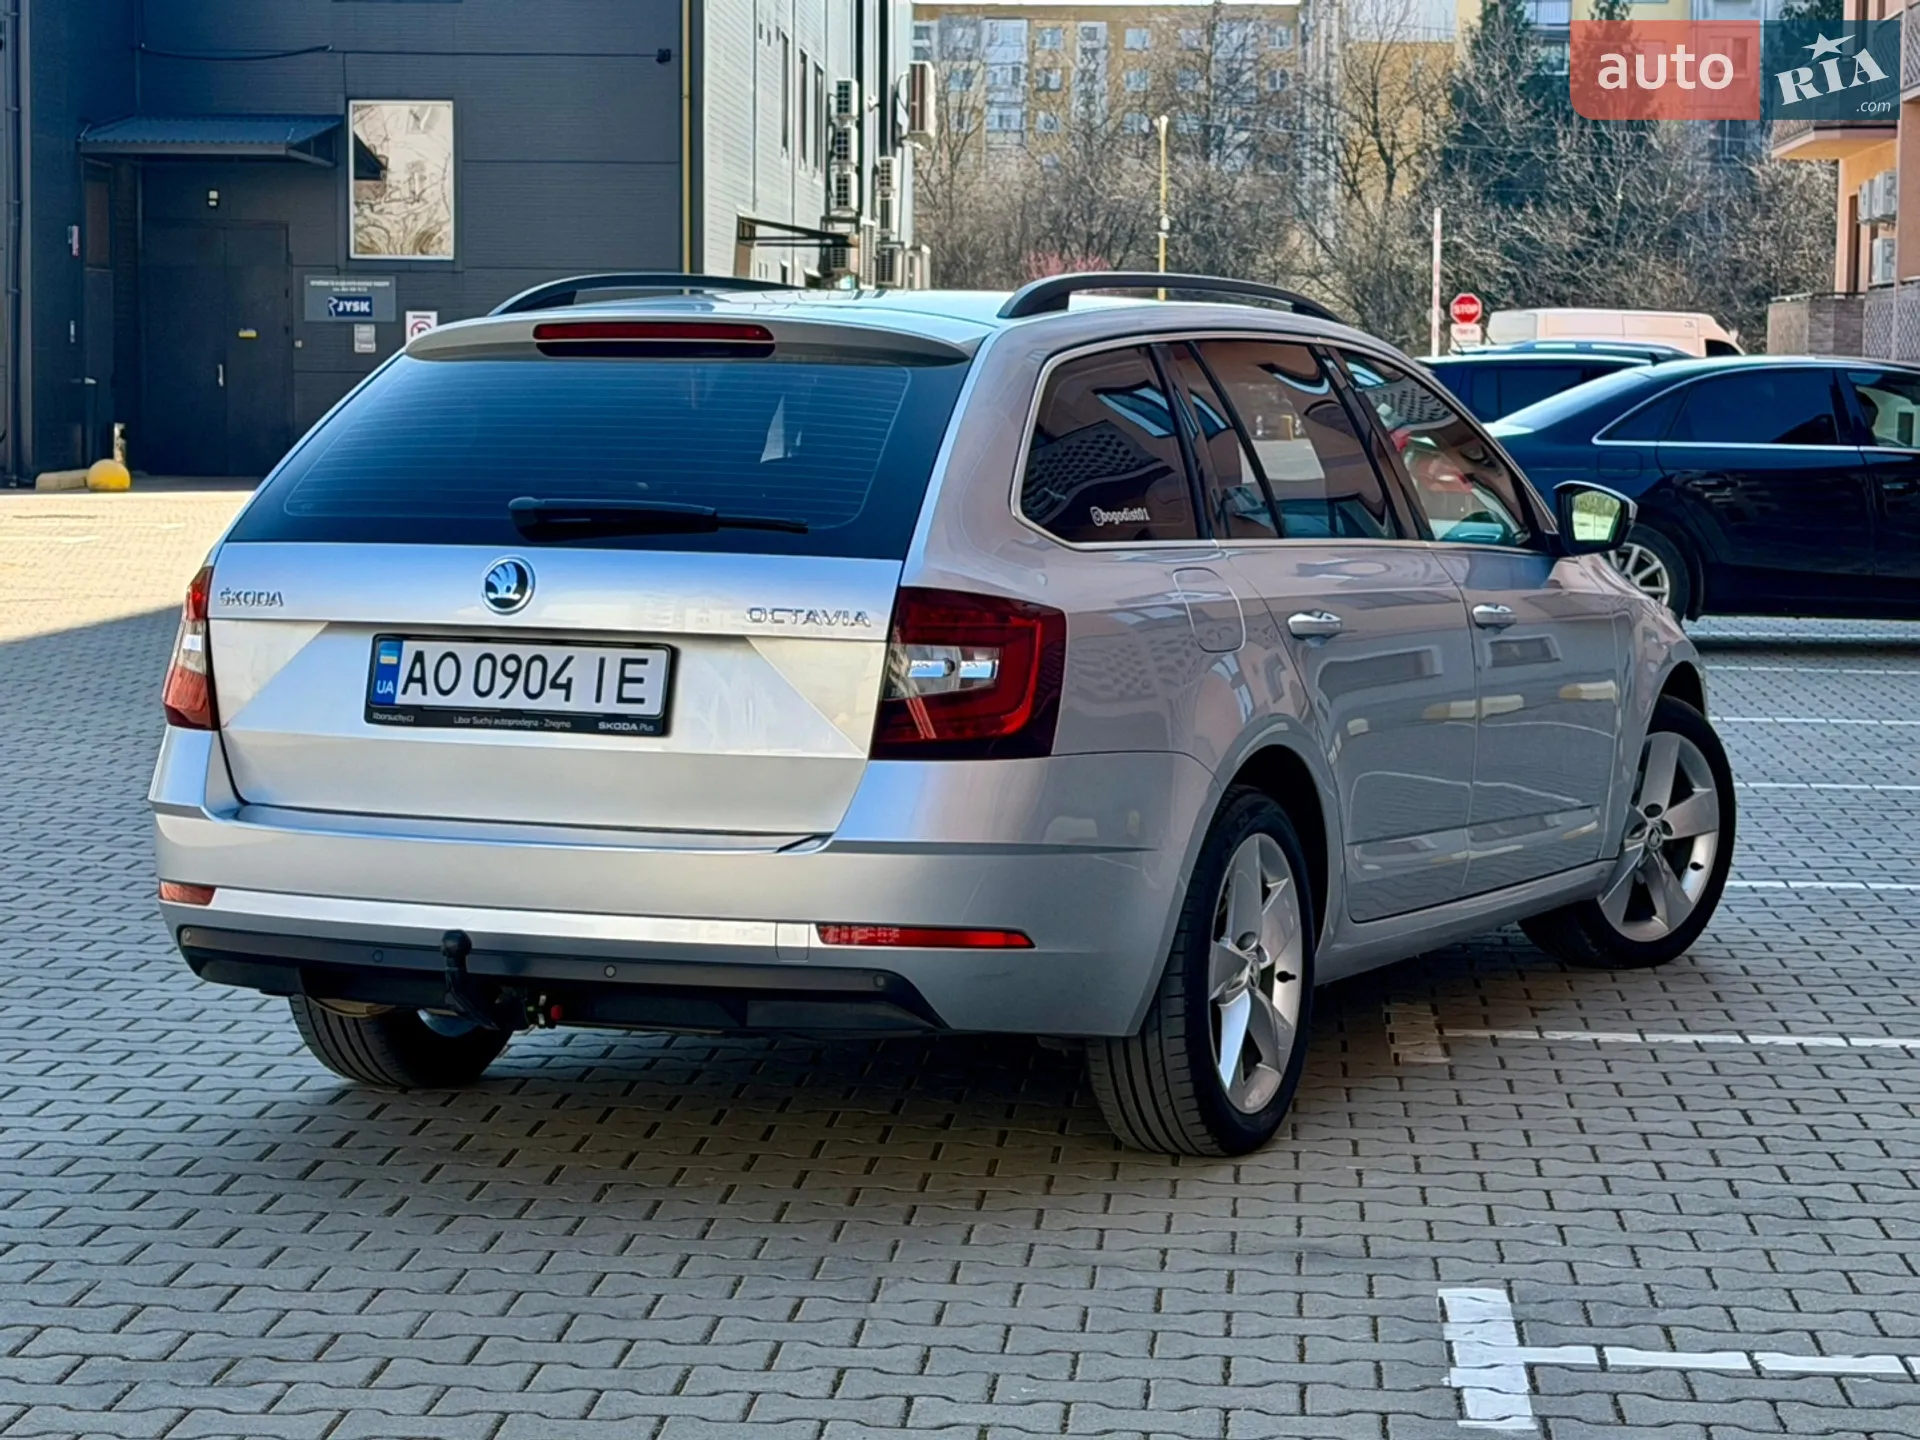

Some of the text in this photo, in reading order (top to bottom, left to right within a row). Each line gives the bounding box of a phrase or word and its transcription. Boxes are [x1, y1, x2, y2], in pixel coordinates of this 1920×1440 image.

[337, 301, 370, 312] JYSK
[746, 607, 871, 627] OCTAVIA
[401, 650, 649, 704] AO 0904 IE
[376, 679, 394, 695] UA
